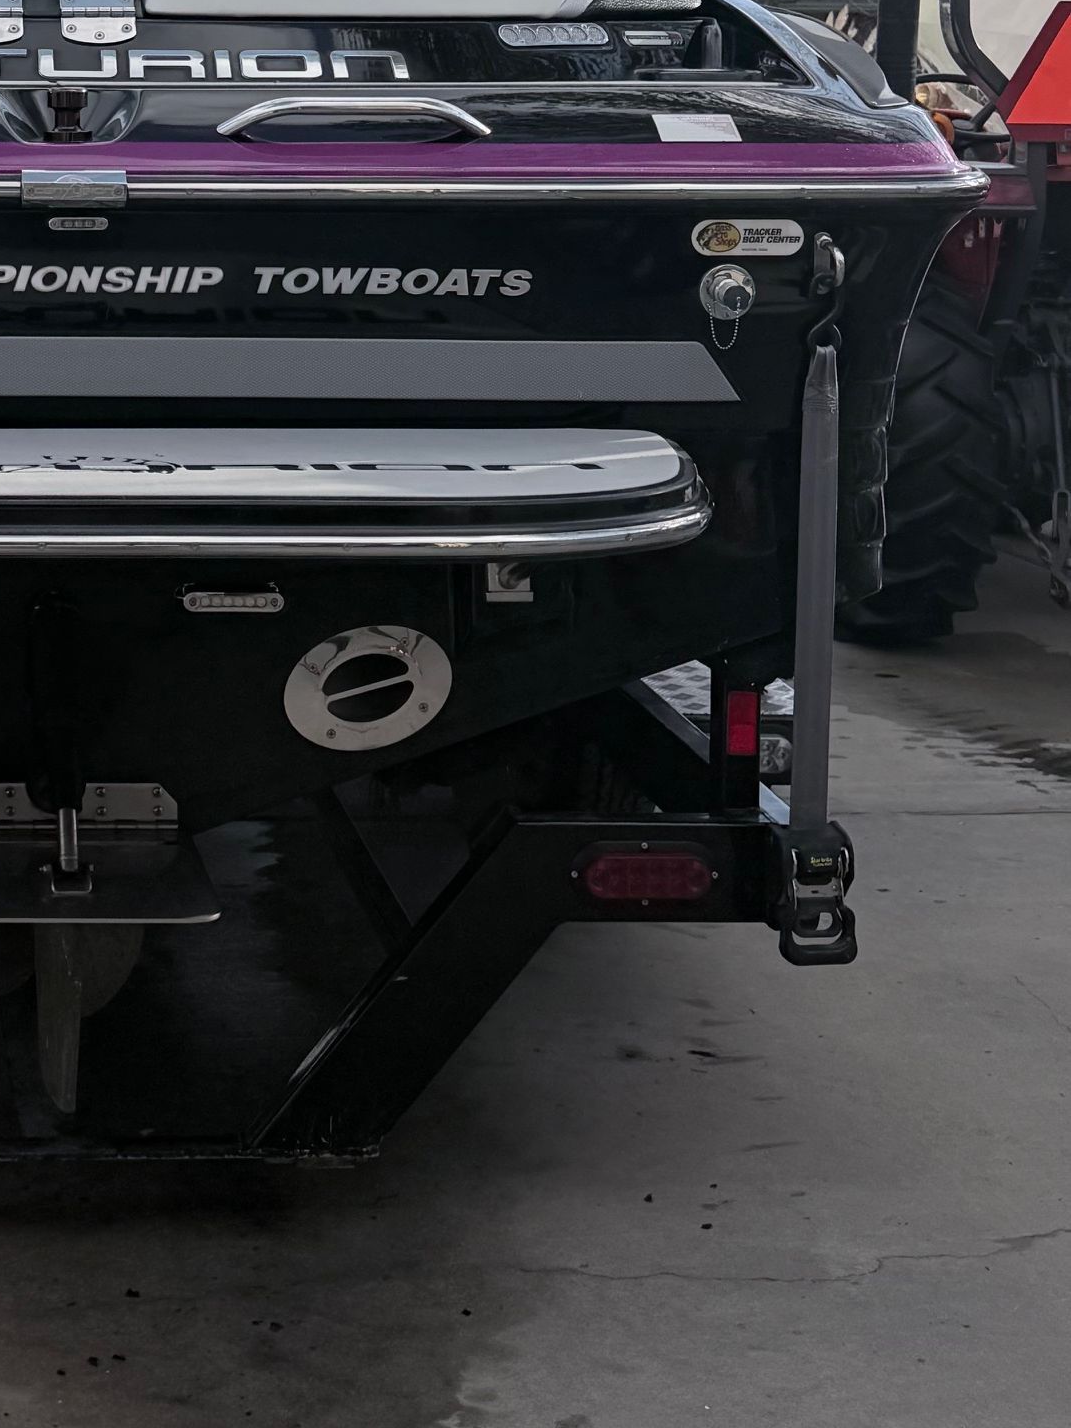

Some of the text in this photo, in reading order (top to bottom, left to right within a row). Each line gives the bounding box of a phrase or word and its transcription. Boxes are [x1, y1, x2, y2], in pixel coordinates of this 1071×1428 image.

[743, 228, 783, 236] TRACKER
[742, 236, 801, 244] BOAT CENTER
[254, 267, 533, 297] TOWBOATS
